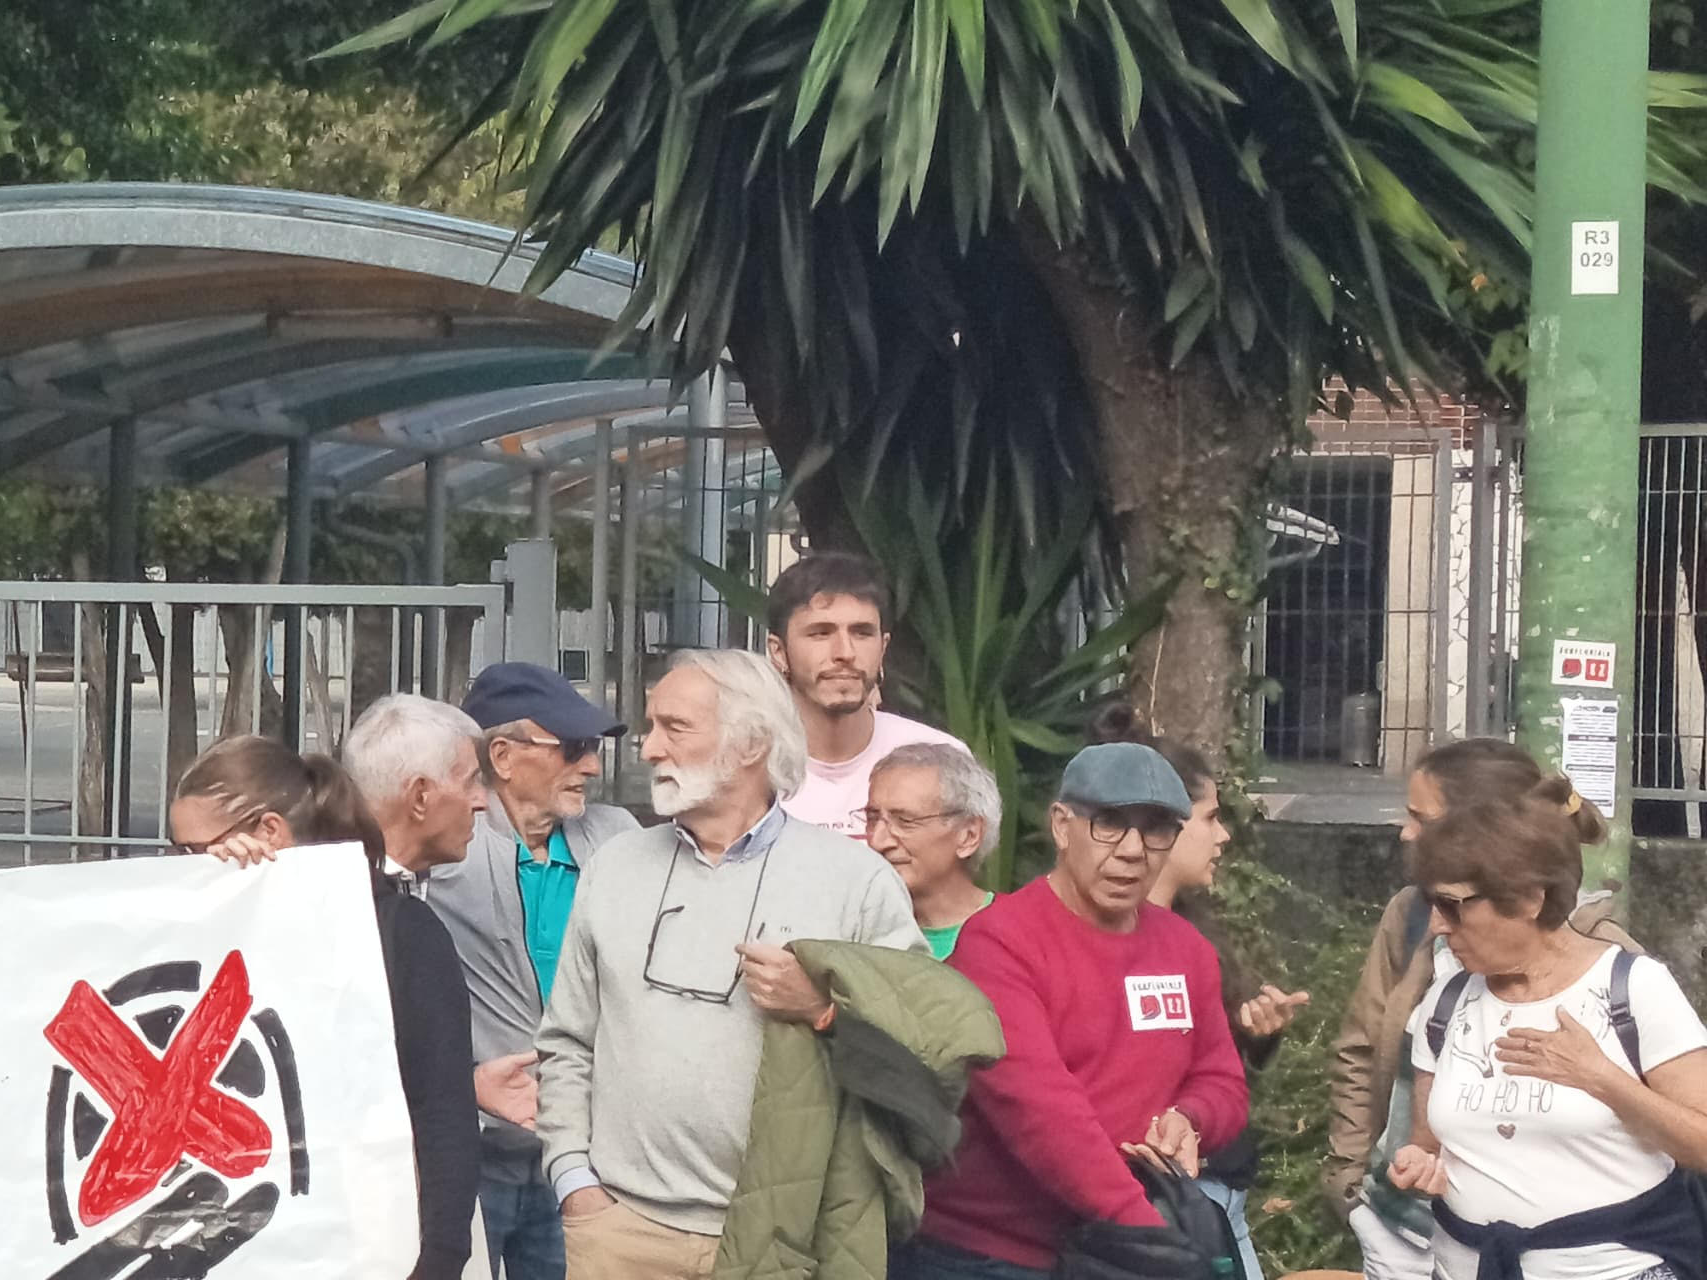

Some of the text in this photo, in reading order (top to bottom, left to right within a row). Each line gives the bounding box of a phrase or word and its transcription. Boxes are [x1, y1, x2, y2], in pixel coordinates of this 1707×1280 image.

[1584, 230, 1610, 246] R3
[1580, 252, 1614, 268] 029
[1455, 1079, 1554, 1114] HO HO HO
